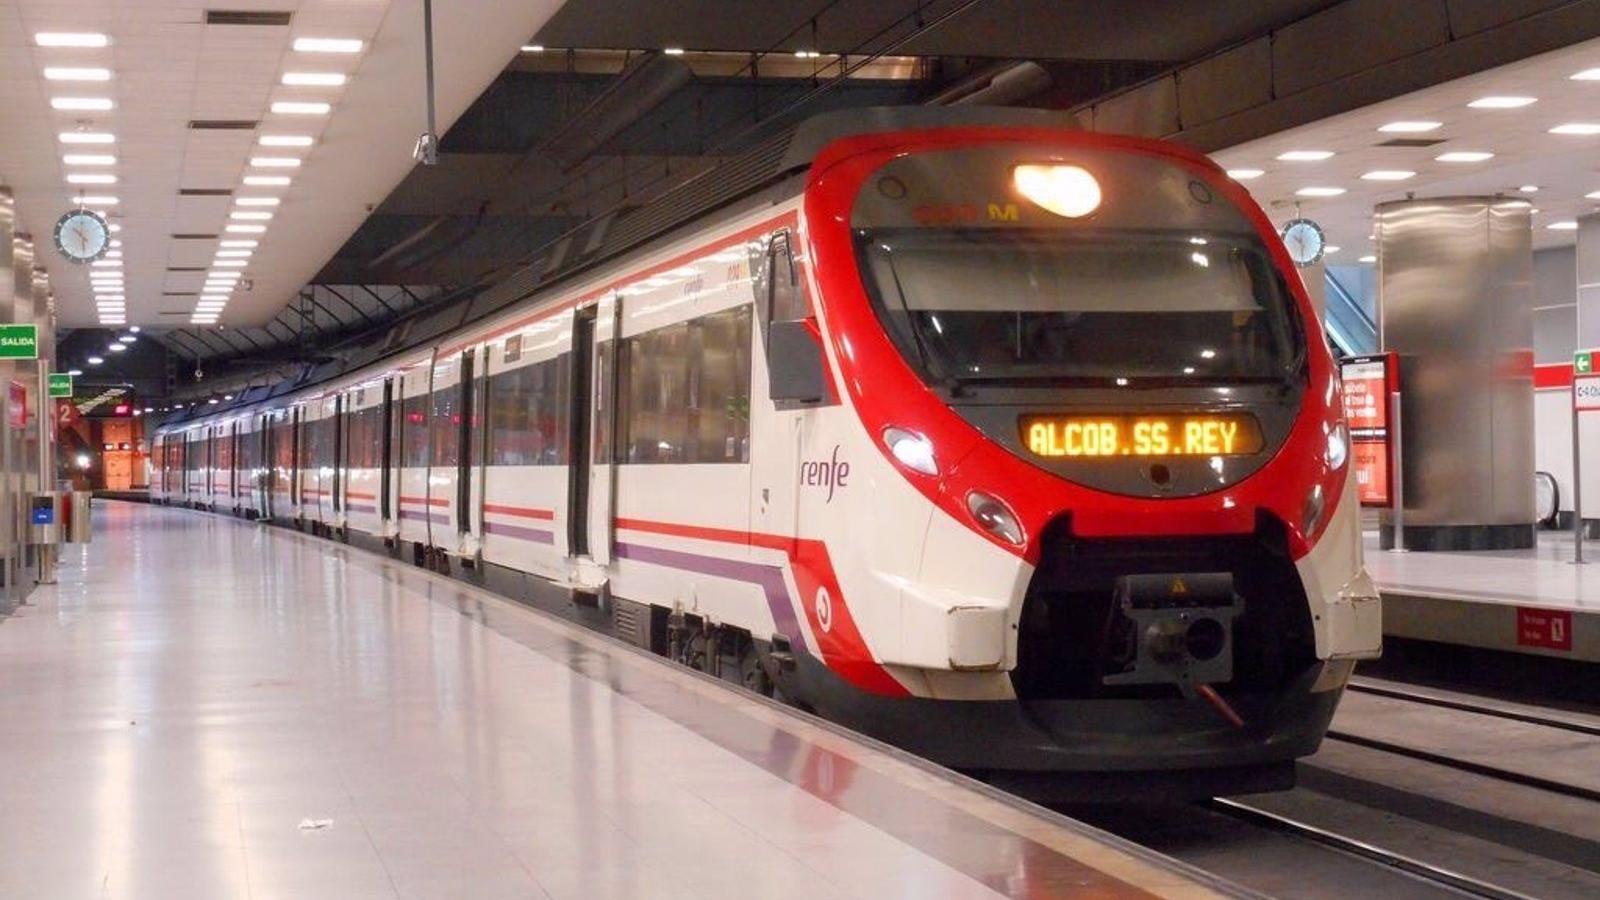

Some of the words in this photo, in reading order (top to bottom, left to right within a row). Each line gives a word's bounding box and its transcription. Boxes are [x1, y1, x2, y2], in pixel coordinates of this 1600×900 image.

[1, 337, 34, 346] SALIDA
[60, 405, 71, 422] 2
[800, 444, 849, 504] renfe
